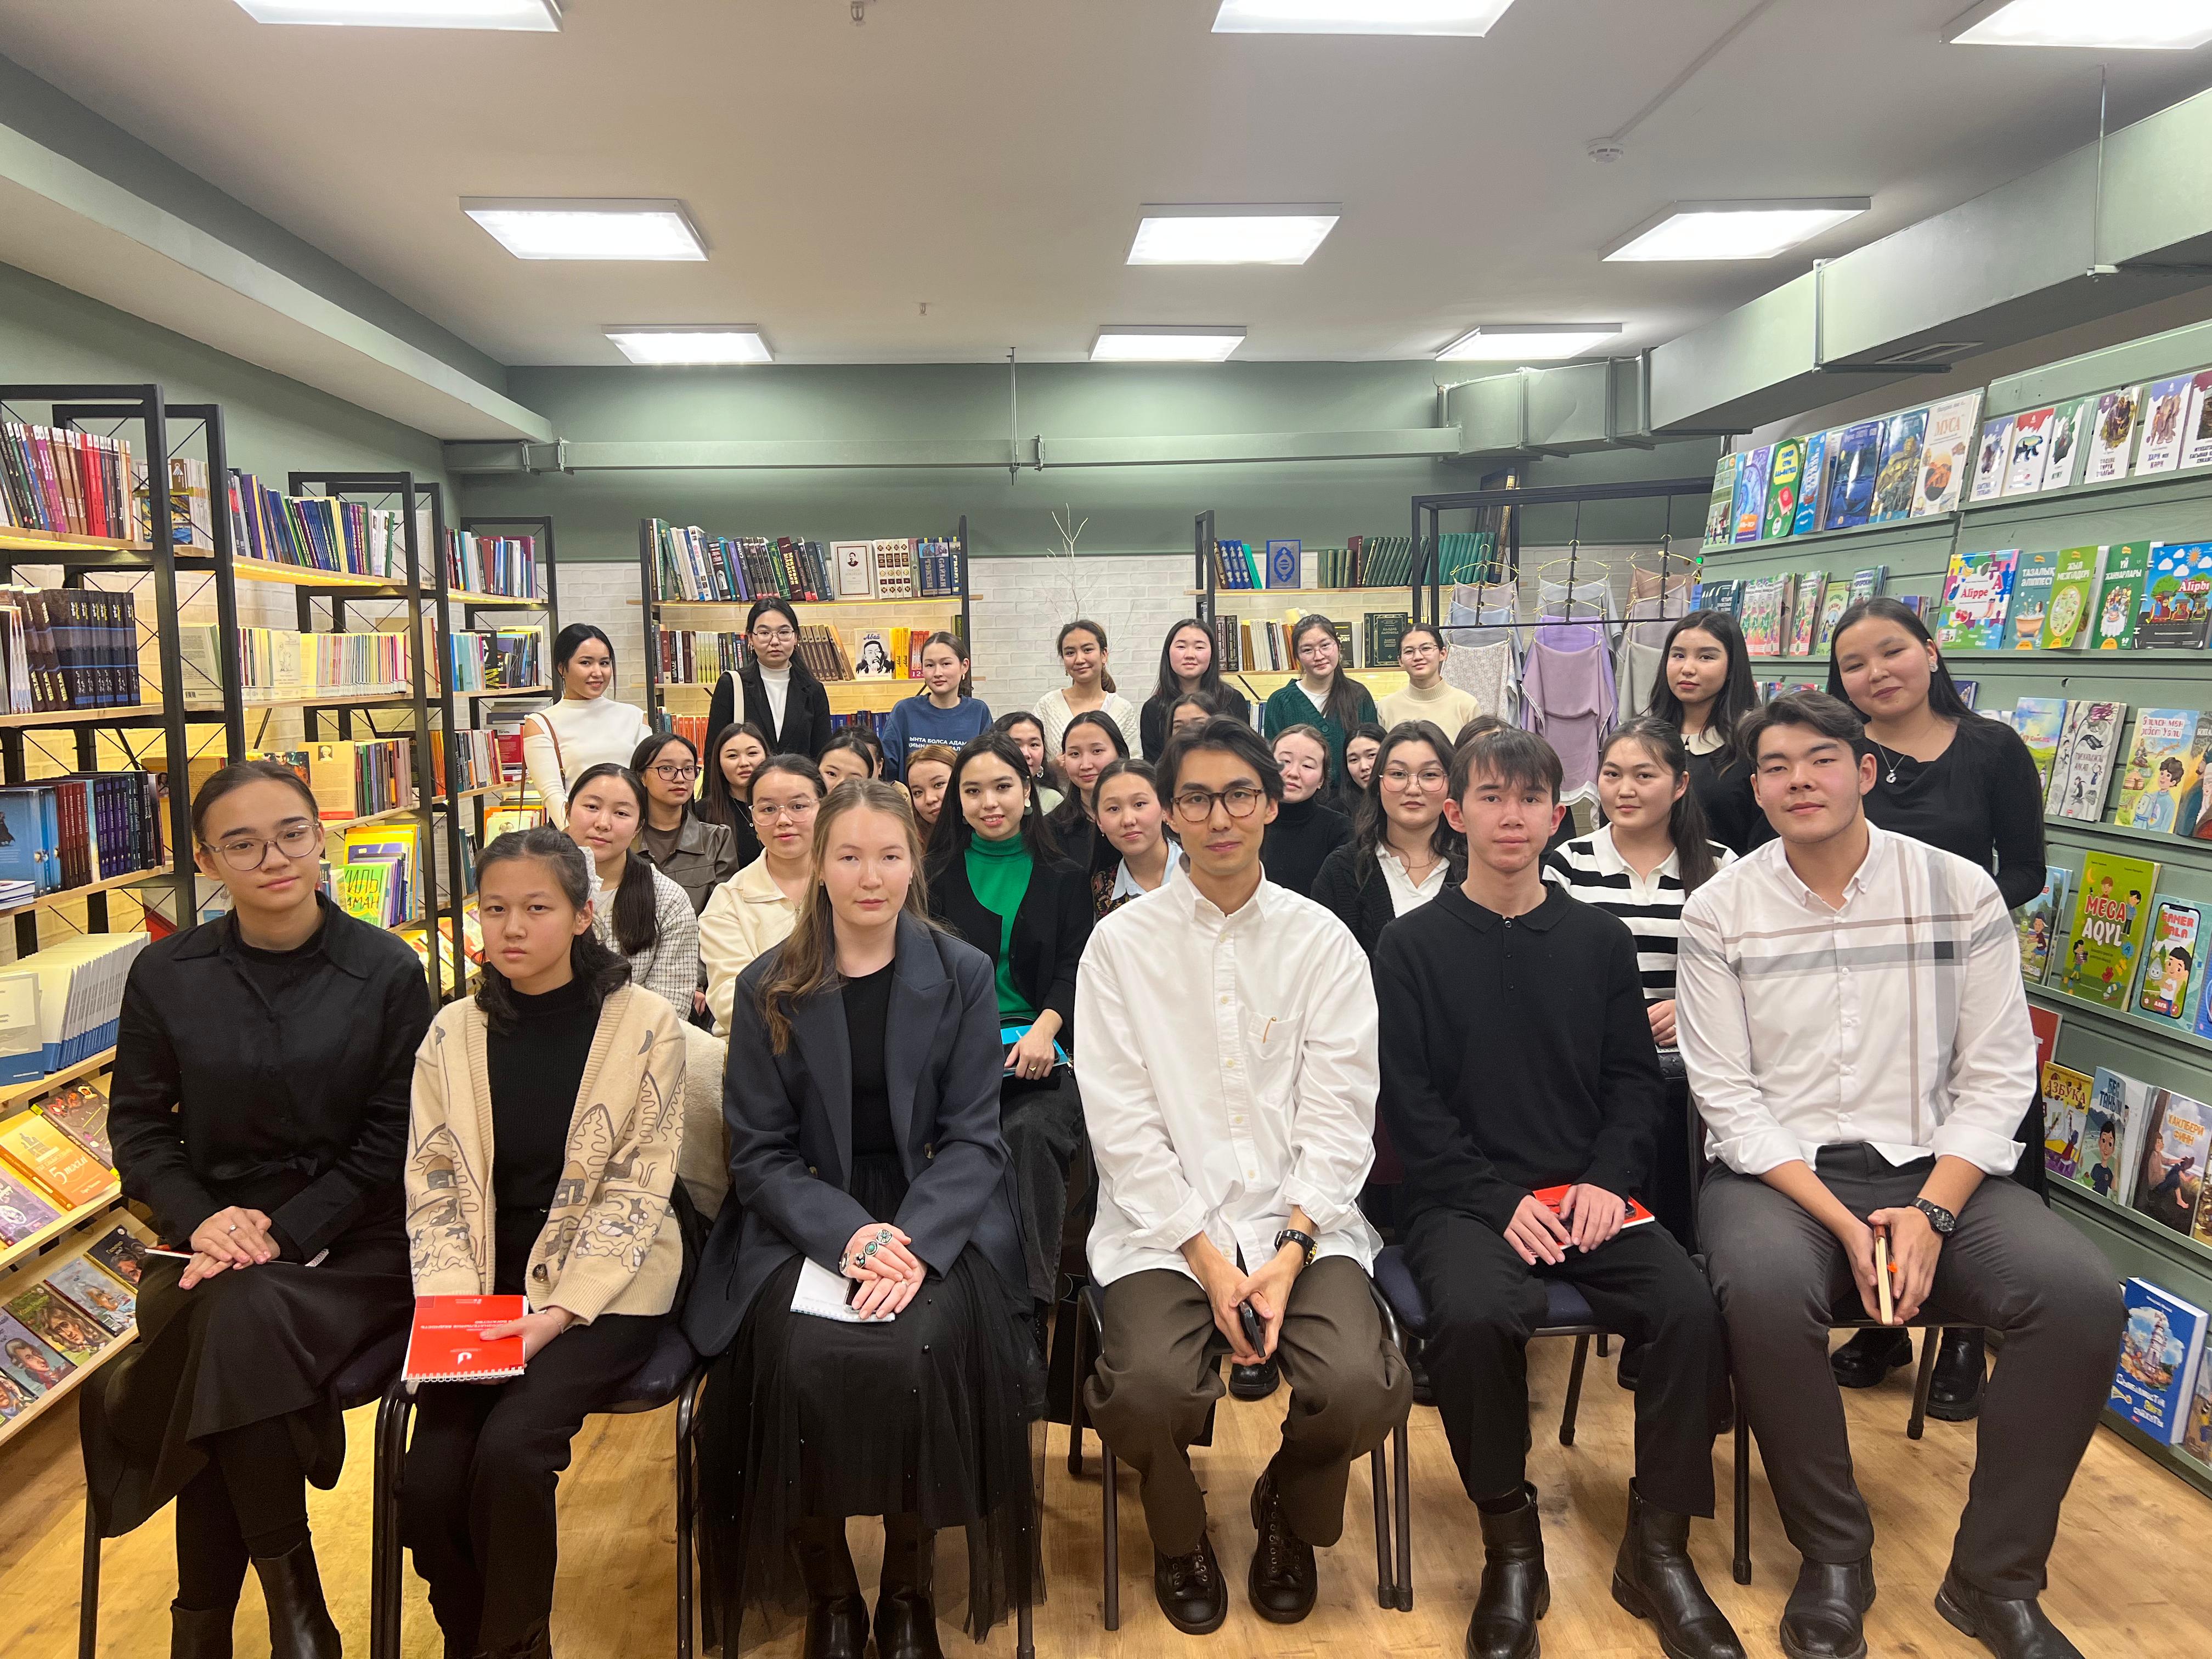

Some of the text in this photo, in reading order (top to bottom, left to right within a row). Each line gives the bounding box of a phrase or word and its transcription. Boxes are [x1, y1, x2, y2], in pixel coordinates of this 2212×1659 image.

[1934, 417, 1960, 436] МУСА
[2022, 567, 2056, 577] ТАЗАЛЫҚ
[2067, 561, 2083, 571] ЖЫЛ
[2105, 569, 2142, 580] ЖАНУАРЛАРЫ
[2021, 577, 2052, 587] ӘЛІППЕСІ
[345, 869, 383, 894] ИЛЫ
[2085, 895, 2127, 922] MEGA
[2162, 911, 2194, 928] GAMER
[2082, 917, 2123, 947] AQYL
[2162, 924, 2188, 939] BALA
[2045, 1080, 2086, 1104] АЗБУКА
[2173, 1130, 2195, 1146] ФИНН
[48, 1166, 67, 1185] 5
